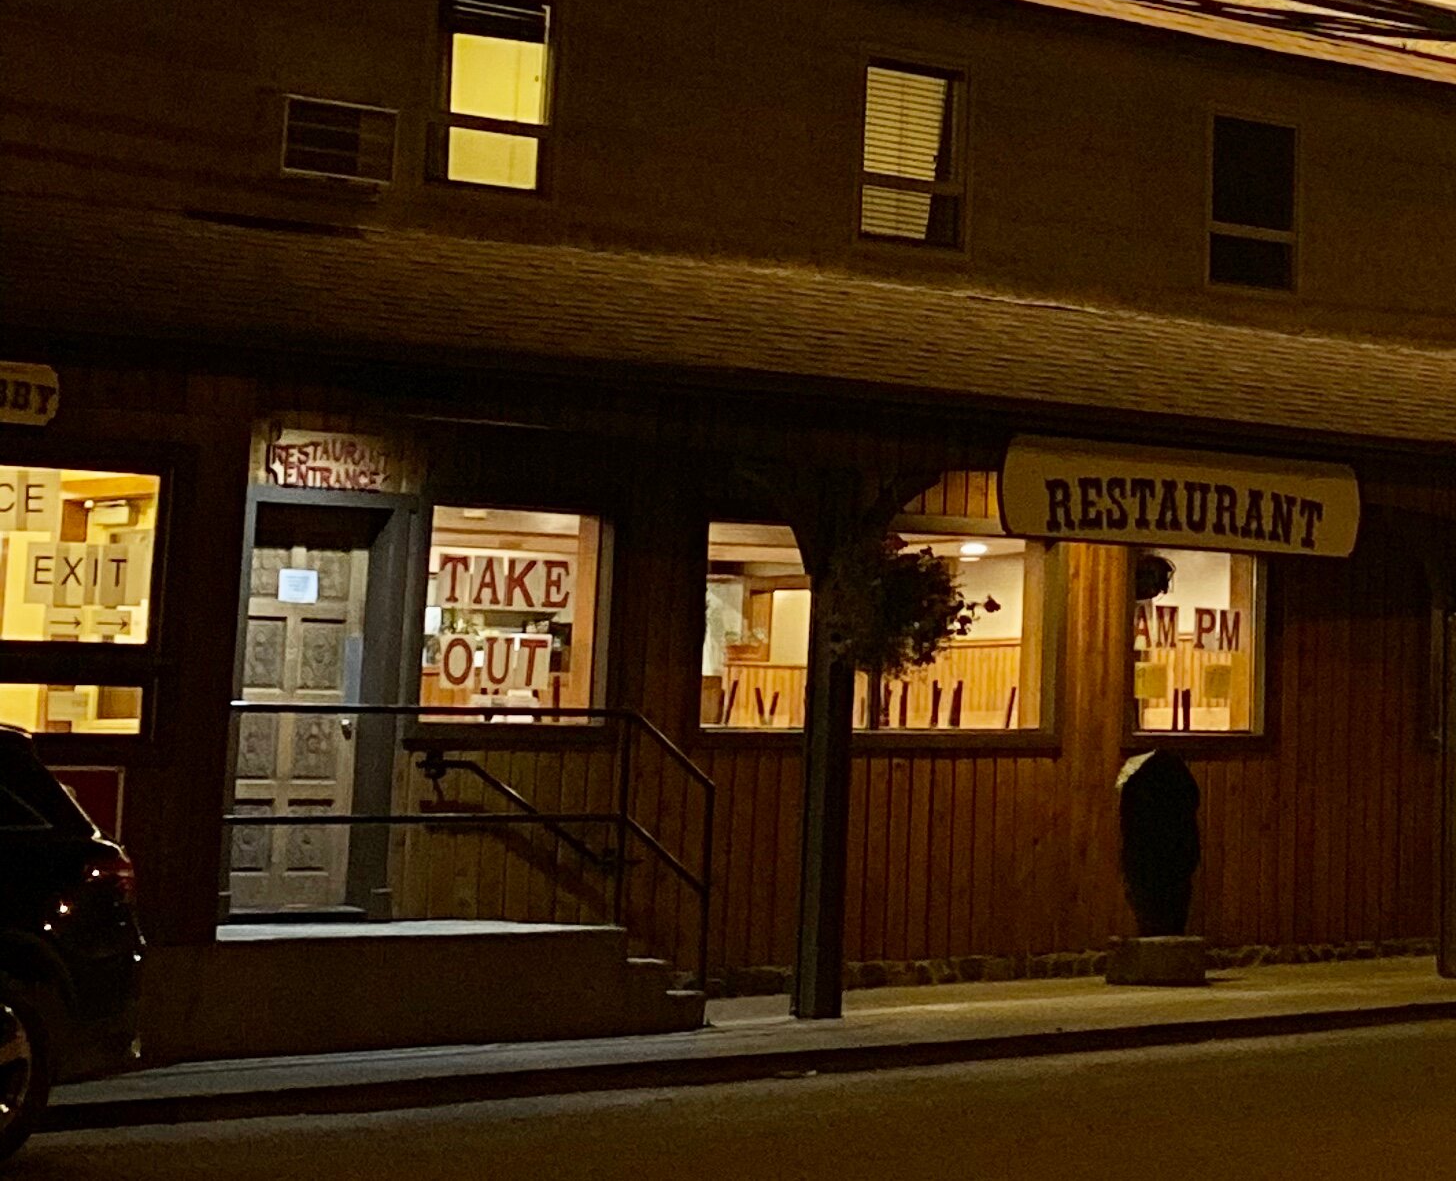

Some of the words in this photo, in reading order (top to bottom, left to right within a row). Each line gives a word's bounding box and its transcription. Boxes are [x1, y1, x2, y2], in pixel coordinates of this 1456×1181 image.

[283, 464, 384, 493] ENTRANCE
[1044, 476, 1324, 550] RESTAURANT
[33, 555, 128, 587] EXIT
[439, 555, 570, 608] TAKE
[1134, 604, 1179, 649] AM
[1193, 607, 1241, 651] PM
[443, 636, 549, 687] OUT
